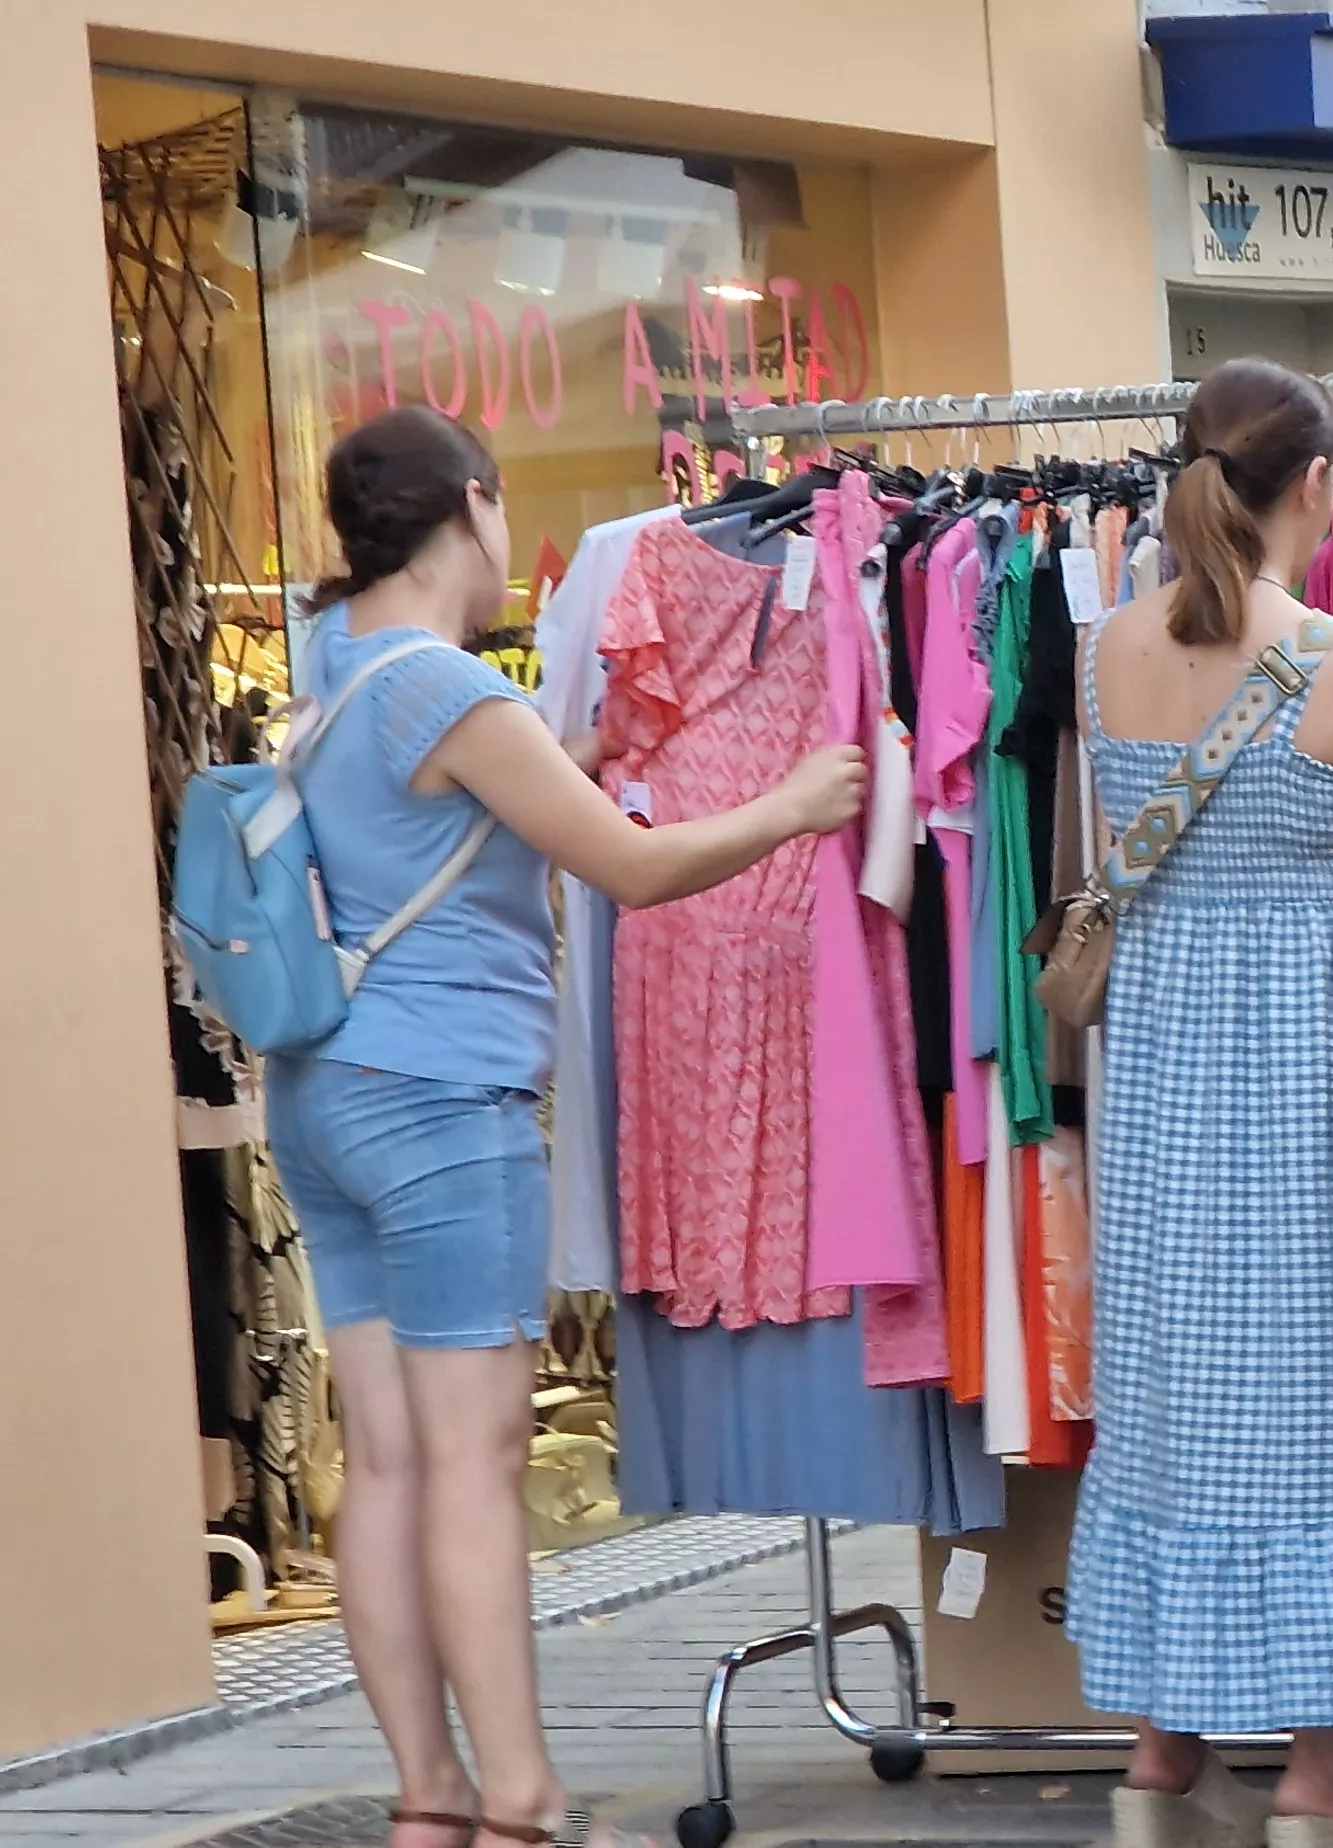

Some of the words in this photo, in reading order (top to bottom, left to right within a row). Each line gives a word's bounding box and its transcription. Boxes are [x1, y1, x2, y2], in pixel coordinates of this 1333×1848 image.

[1206, 175, 1252, 230] hit
[1203, 233, 1261, 263] Huesca
[355, 297, 562, 430] TODO
[622, 298, 664, 416] A
[686, 274, 870, 422] MITAD
